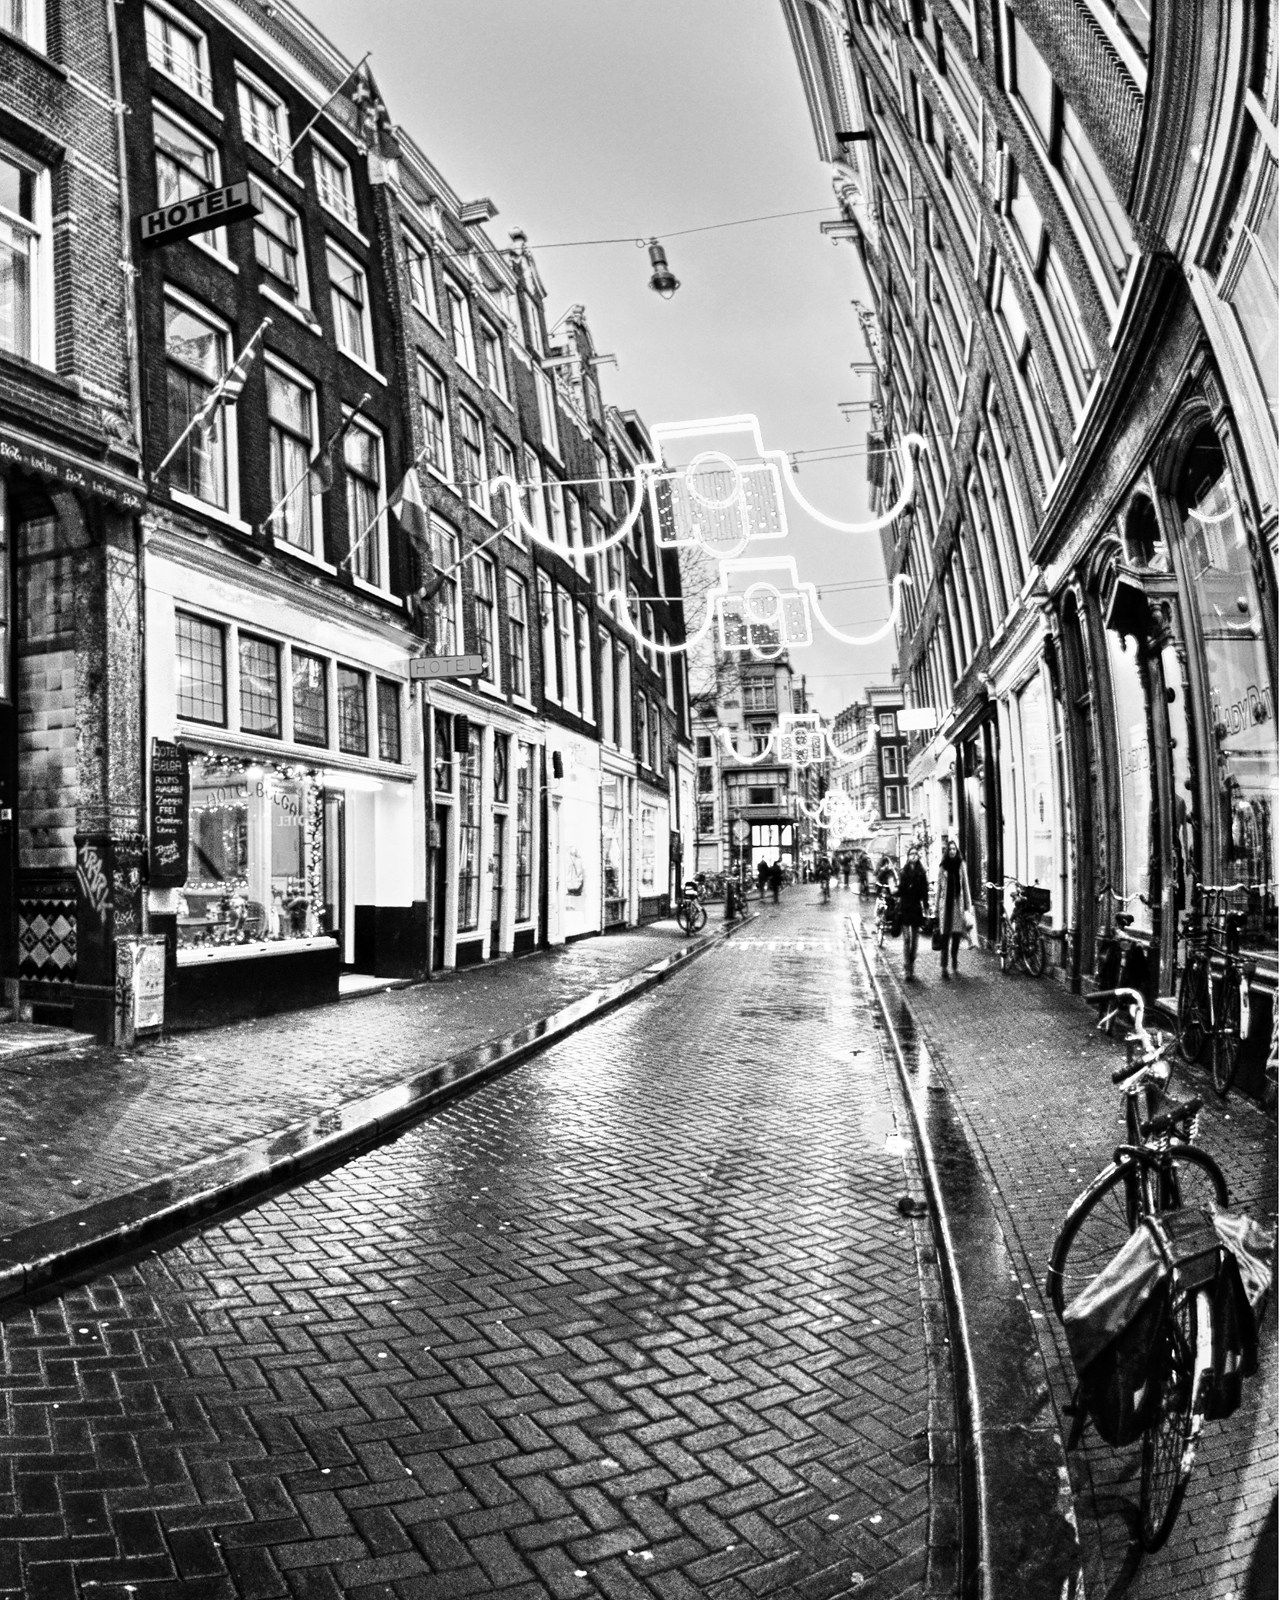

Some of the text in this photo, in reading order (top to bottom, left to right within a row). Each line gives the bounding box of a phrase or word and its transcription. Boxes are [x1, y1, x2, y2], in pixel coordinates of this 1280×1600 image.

[148, 188, 242, 235] HOTEL
[416, 658, 477, 675] HOTEL
[155, 776, 179, 785] ROOMS
